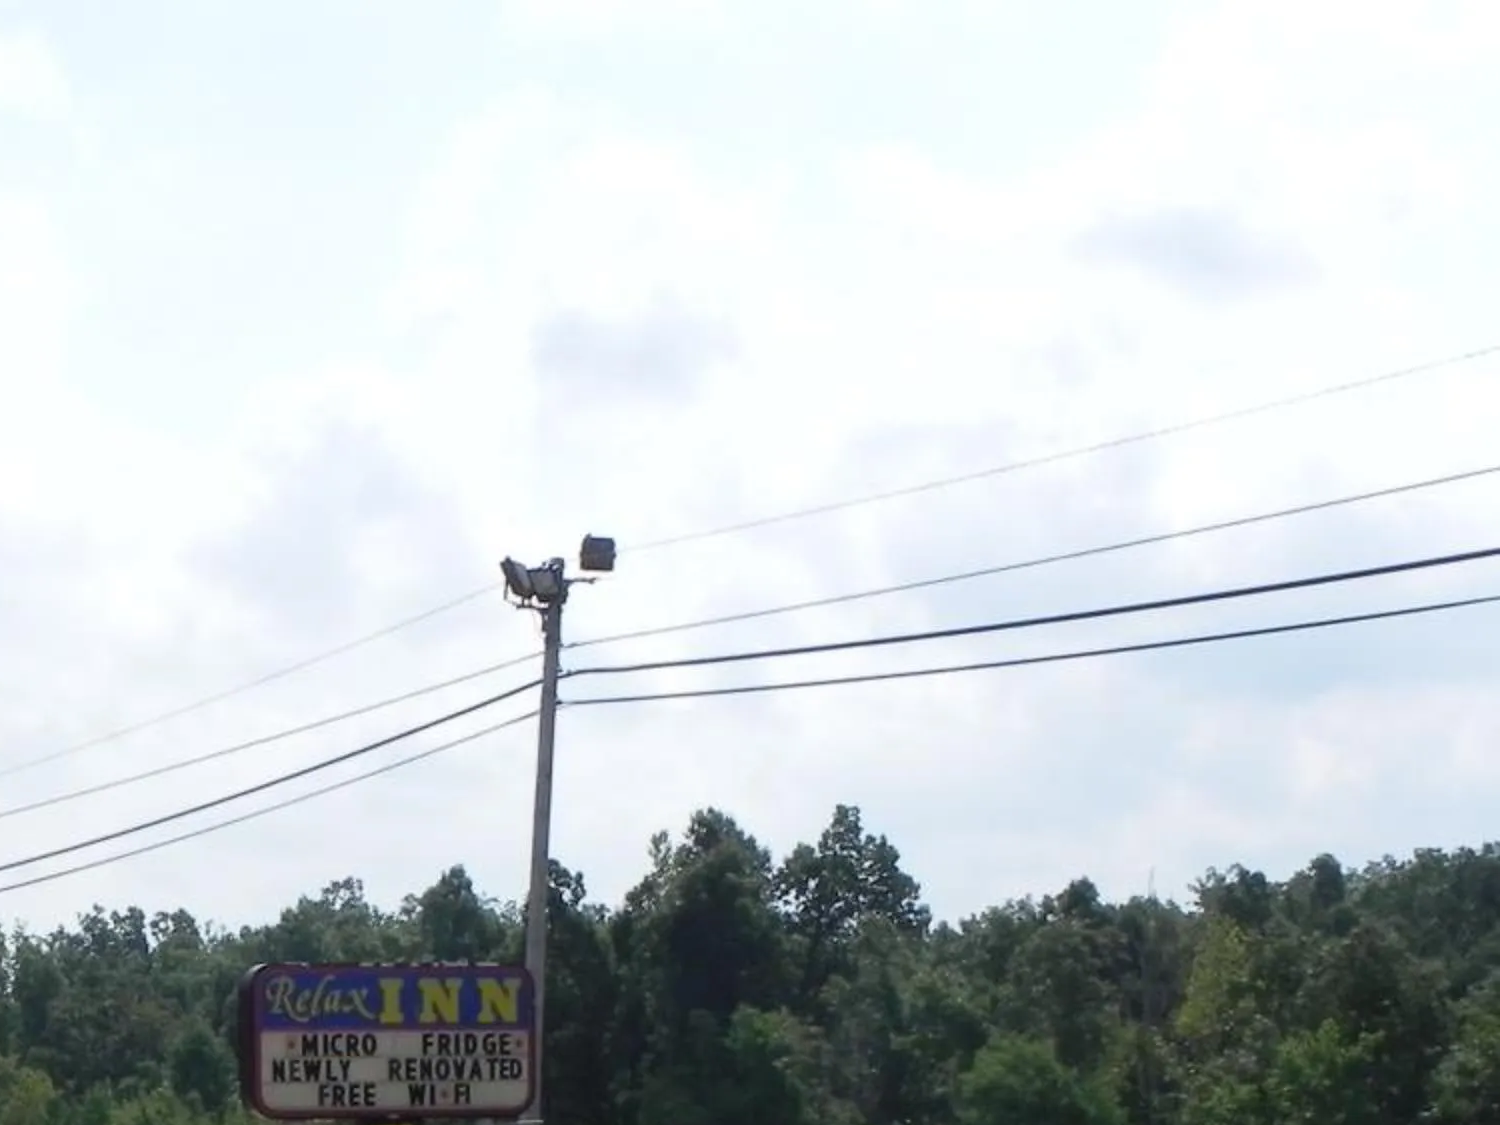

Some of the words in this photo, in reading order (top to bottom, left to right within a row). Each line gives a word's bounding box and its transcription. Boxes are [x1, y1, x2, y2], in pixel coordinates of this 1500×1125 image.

[265, 976, 376, 1022] Relax
[379, 978, 522, 1024] INN
[301, 1034, 377, 1055] MICRO
[422, 1034, 511, 1055] FRIDGE
[272, 1060, 351, 1082] NEWLY
[389, 1059, 522, 1081] RENOVATED
[319, 1085, 376, 1106] FREE
